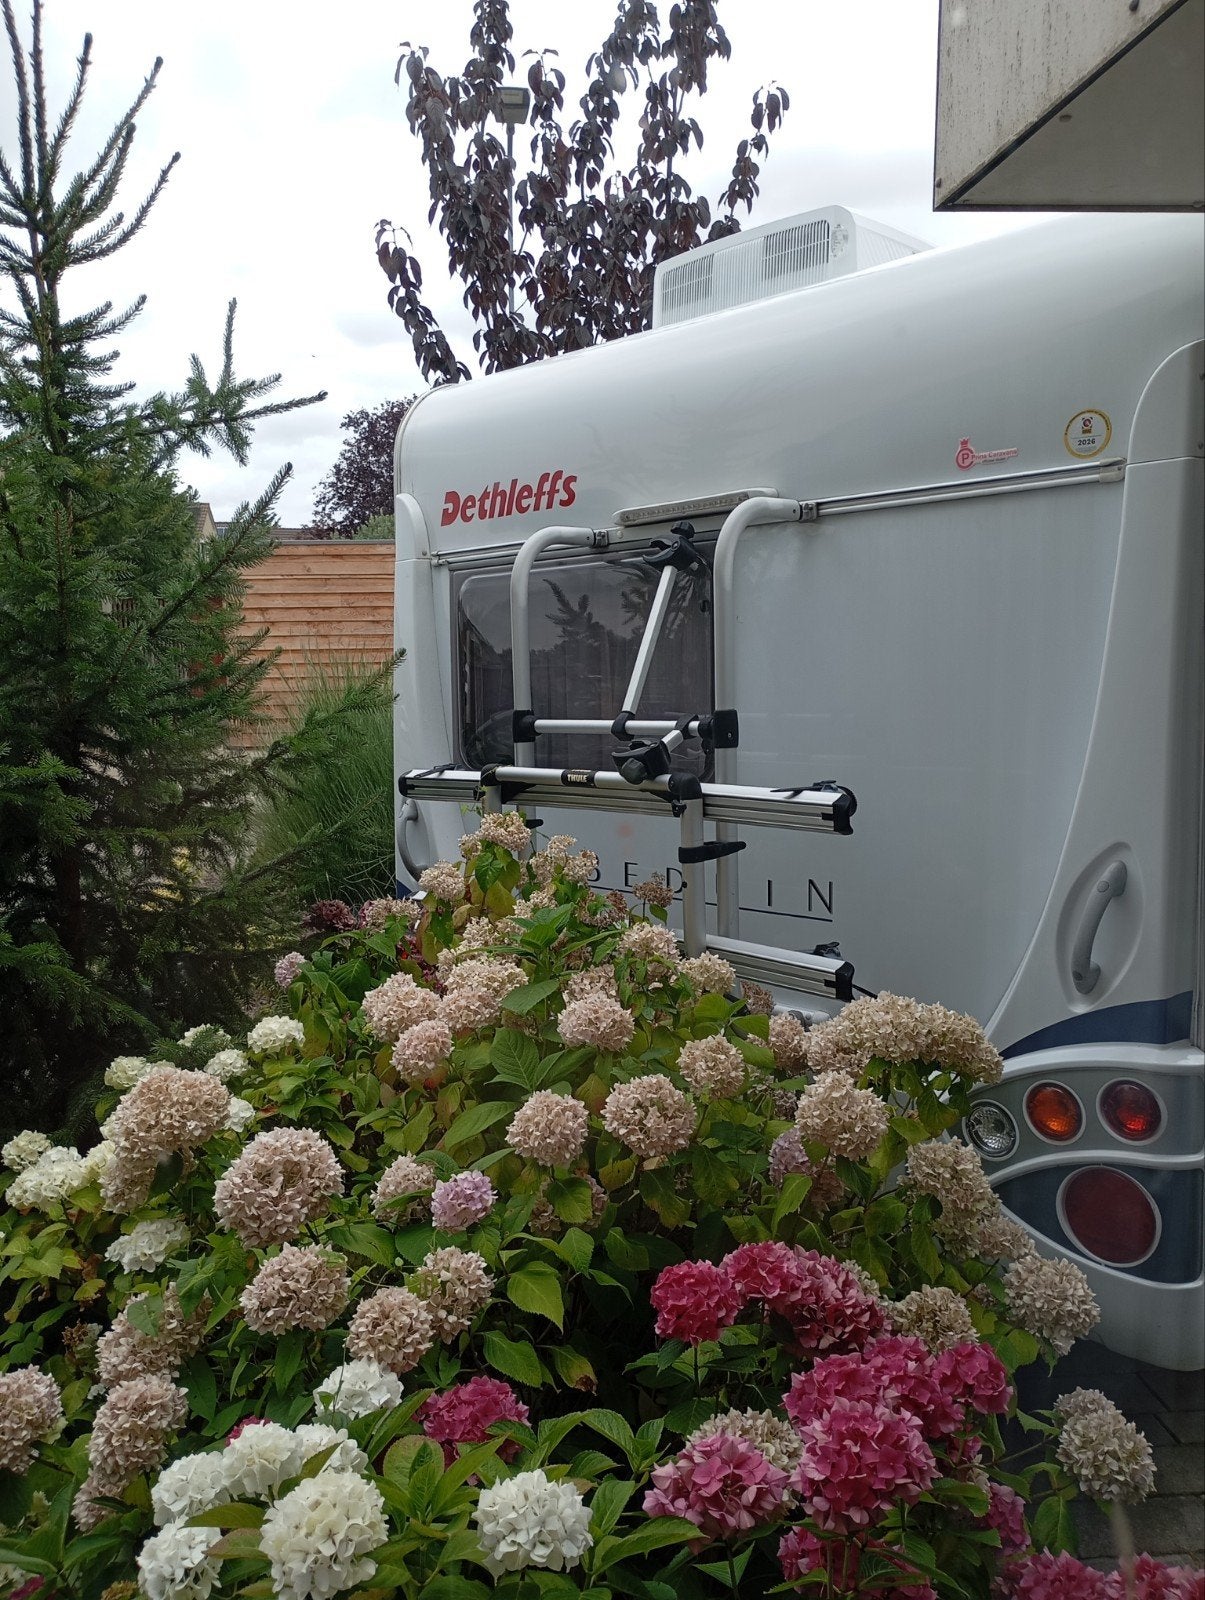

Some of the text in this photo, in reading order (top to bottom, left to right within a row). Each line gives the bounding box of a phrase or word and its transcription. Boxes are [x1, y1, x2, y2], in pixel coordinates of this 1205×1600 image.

[1077, 438, 1096, 446] 2026
[440, 469, 578, 527] Dethleffs
[567, 773, 588, 783] THULE
